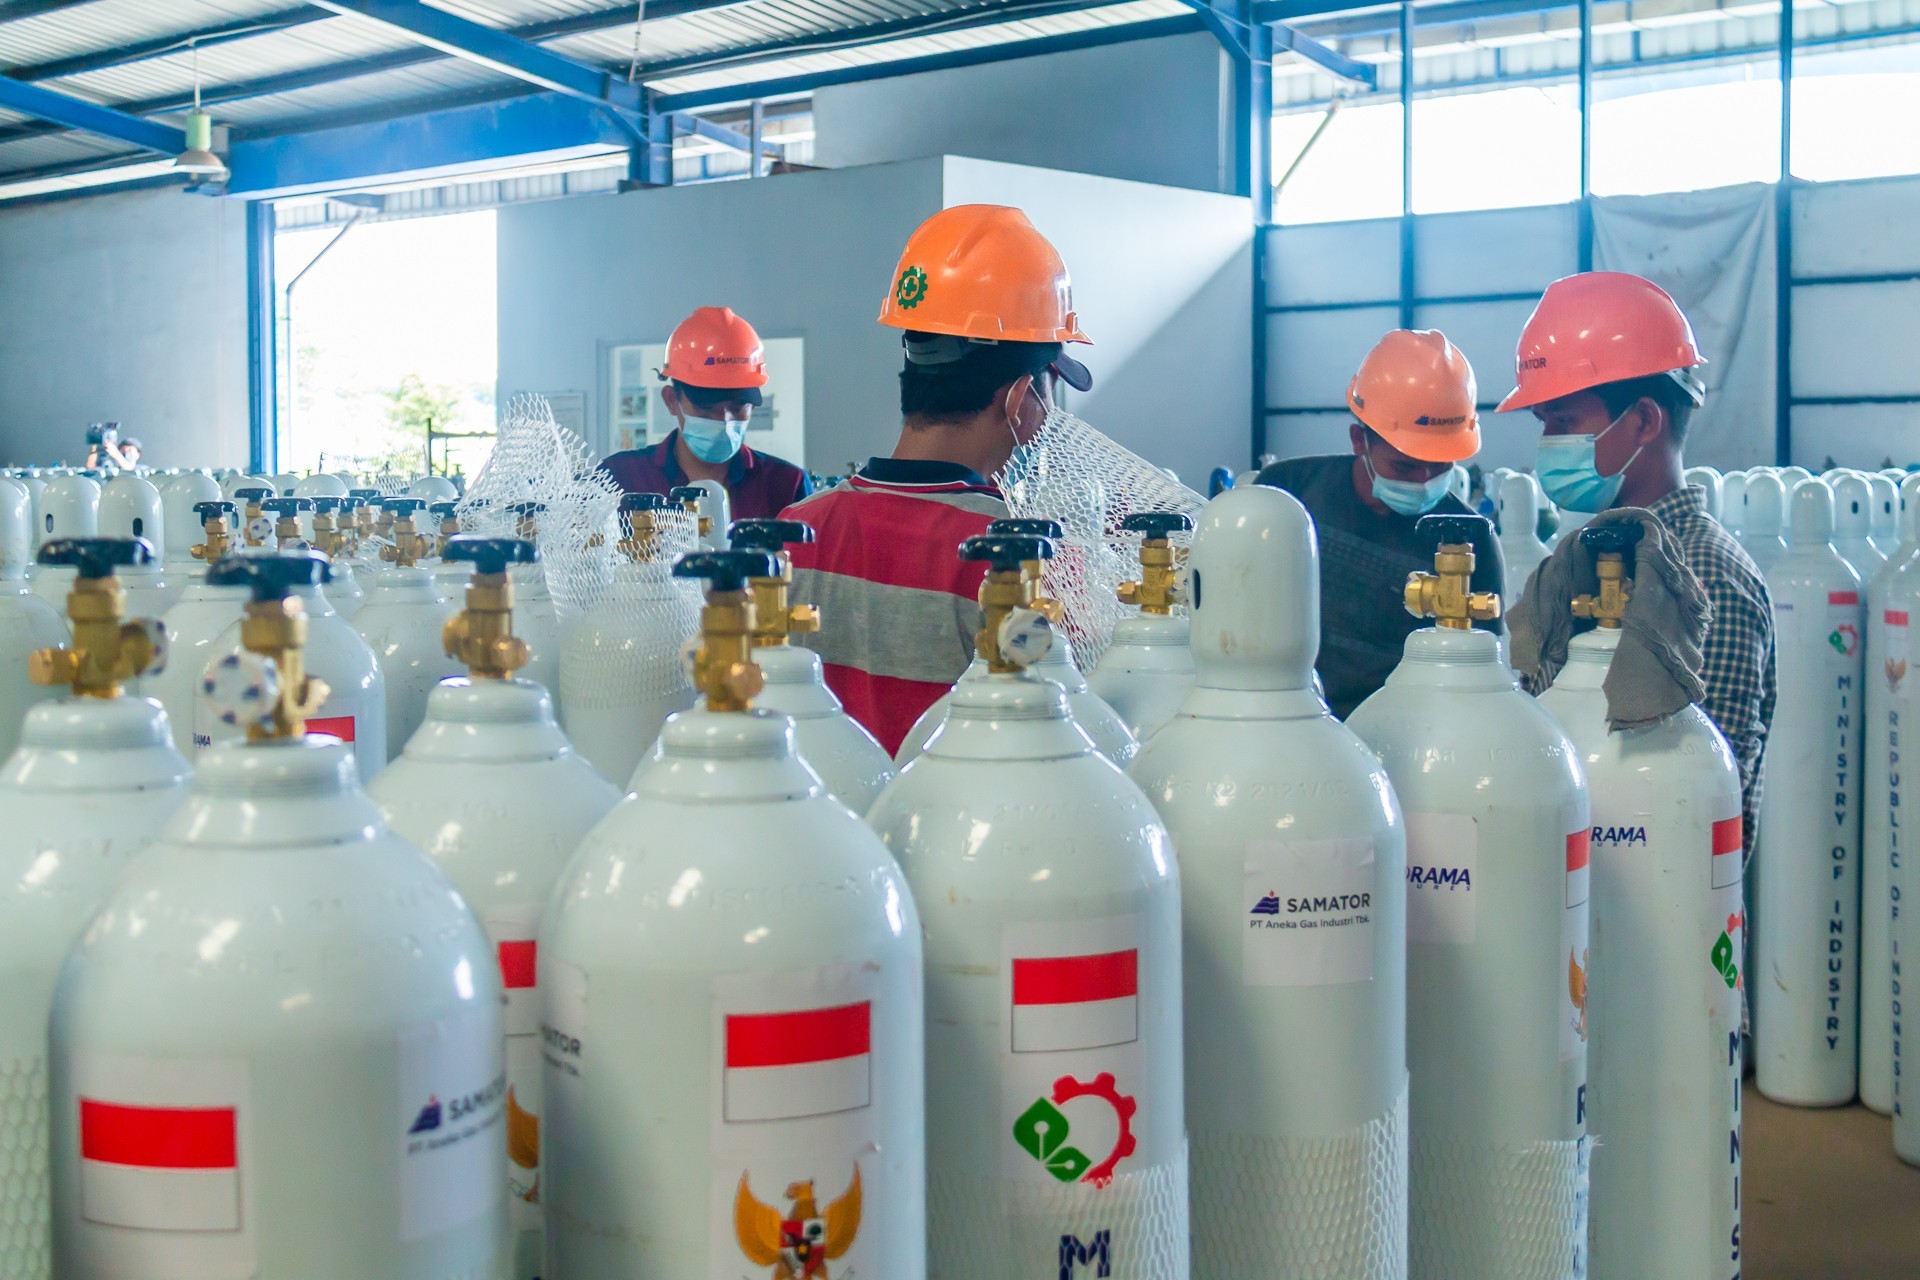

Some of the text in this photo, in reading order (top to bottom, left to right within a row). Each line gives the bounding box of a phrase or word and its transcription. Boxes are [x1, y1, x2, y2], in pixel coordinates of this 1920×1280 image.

[1888, 710, 1900, 868] REPUBLIC
[1826, 675, 1851, 1050] MINISTRY OF INDUSTRY
[1287, 893, 1371, 913] SAMATOR
[1890, 885, 1901, 920] OF
[1250, 920, 1263, 928] PT
[1265, 919, 1297, 929] Aneka
[1300, 919, 1318, 928] Gas
[1320, 917, 1354, 928] Industri
